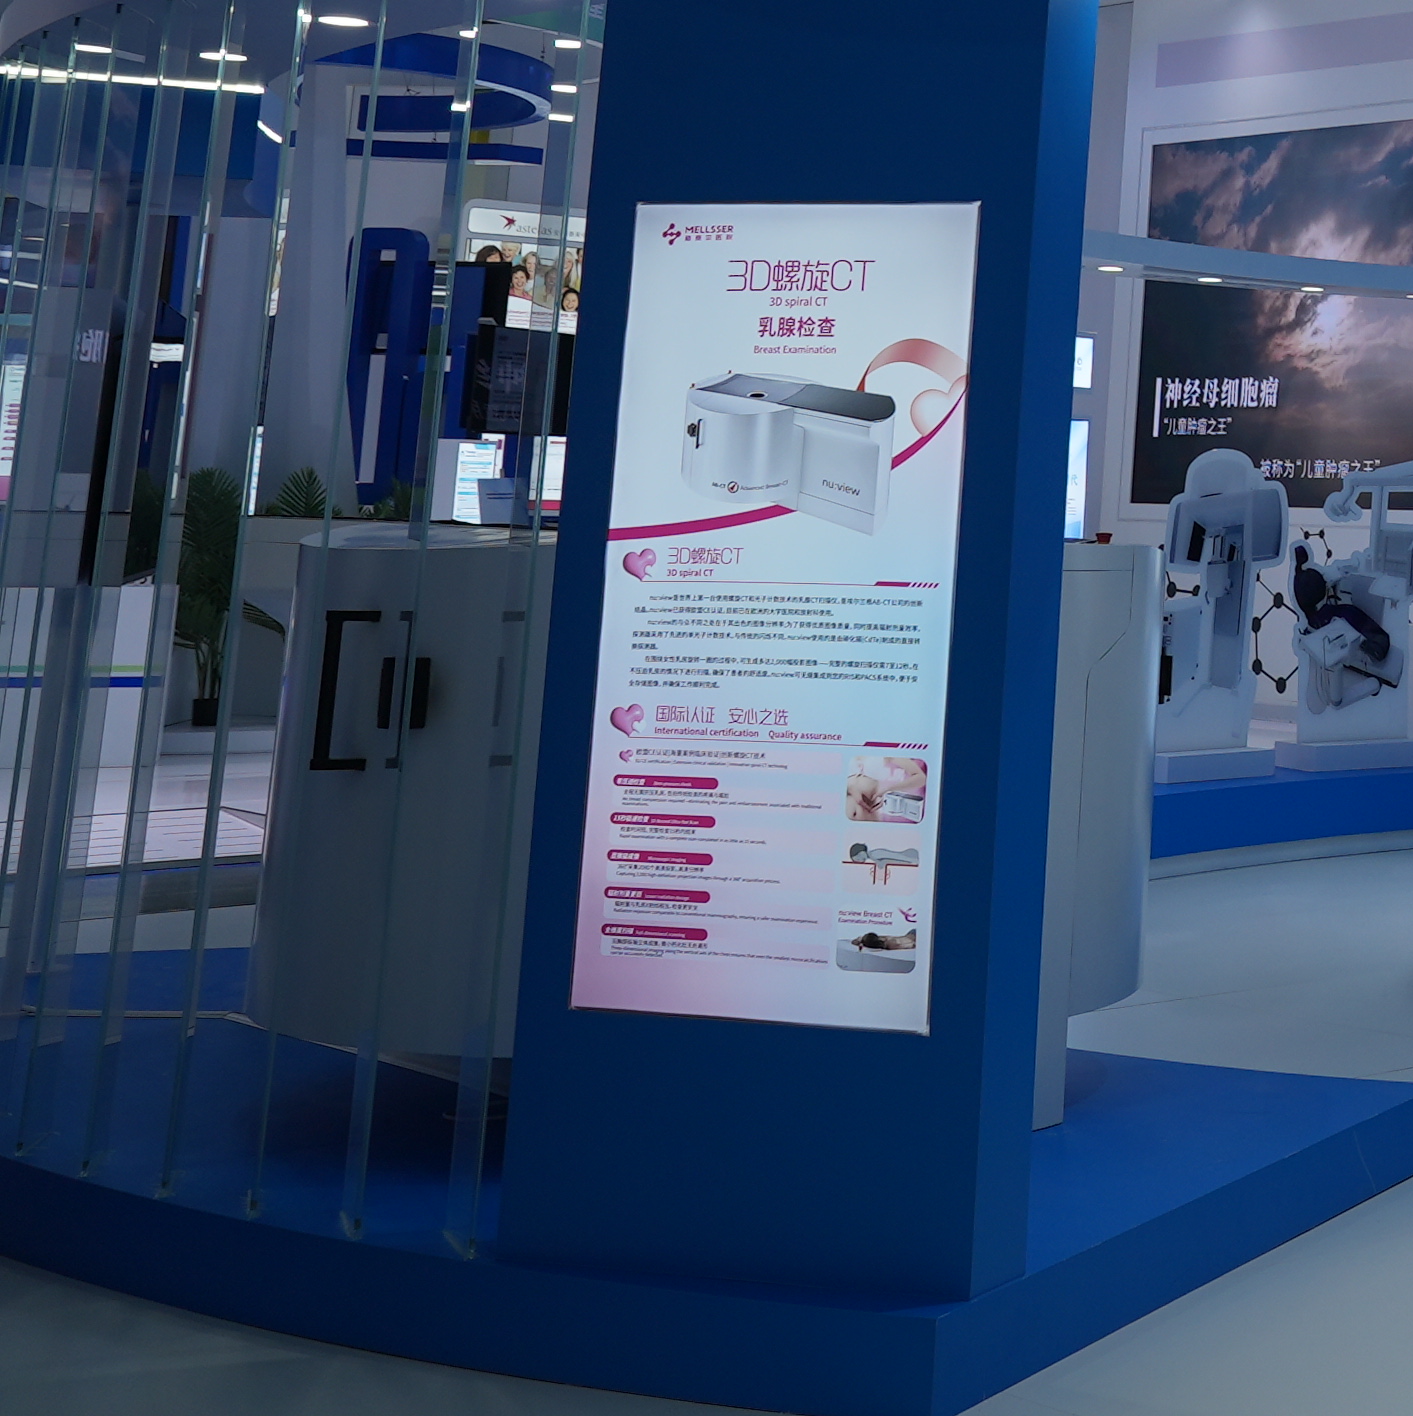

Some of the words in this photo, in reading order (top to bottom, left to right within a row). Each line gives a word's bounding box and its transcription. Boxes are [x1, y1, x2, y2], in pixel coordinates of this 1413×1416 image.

[685, 225, 734, 234] MELLSSER
[726, 259, 876, 292] 3D螺旋CT
[769, 297, 782, 306] 3D
[785, 296, 813, 308] spiral
[815, 297, 828, 307] CT
[758, 316, 836, 338] 乳腺检查
[754, 345, 781, 354] Breast
[783, 345, 837, 354] Examination
[1164, 375, 1280, 410] 神经母细胞瘤
[822, 479, 860, 496] nu:view
[668, 547, 744, 566] 3D螺旋CT
[667, 569, 677, 577] 3D
[679, 568, 702, 579] spiral
[703, 569, 713, 577] CT
[655, 705, 716, 724] 国际认证
[728, 708, 789, 726] 安心之选
[654, 726, 708, 736] International
[709, 728, 759, 738] certification
[769, 730, 798, 741] Quality
[800, 732, 842, 742] assurance
